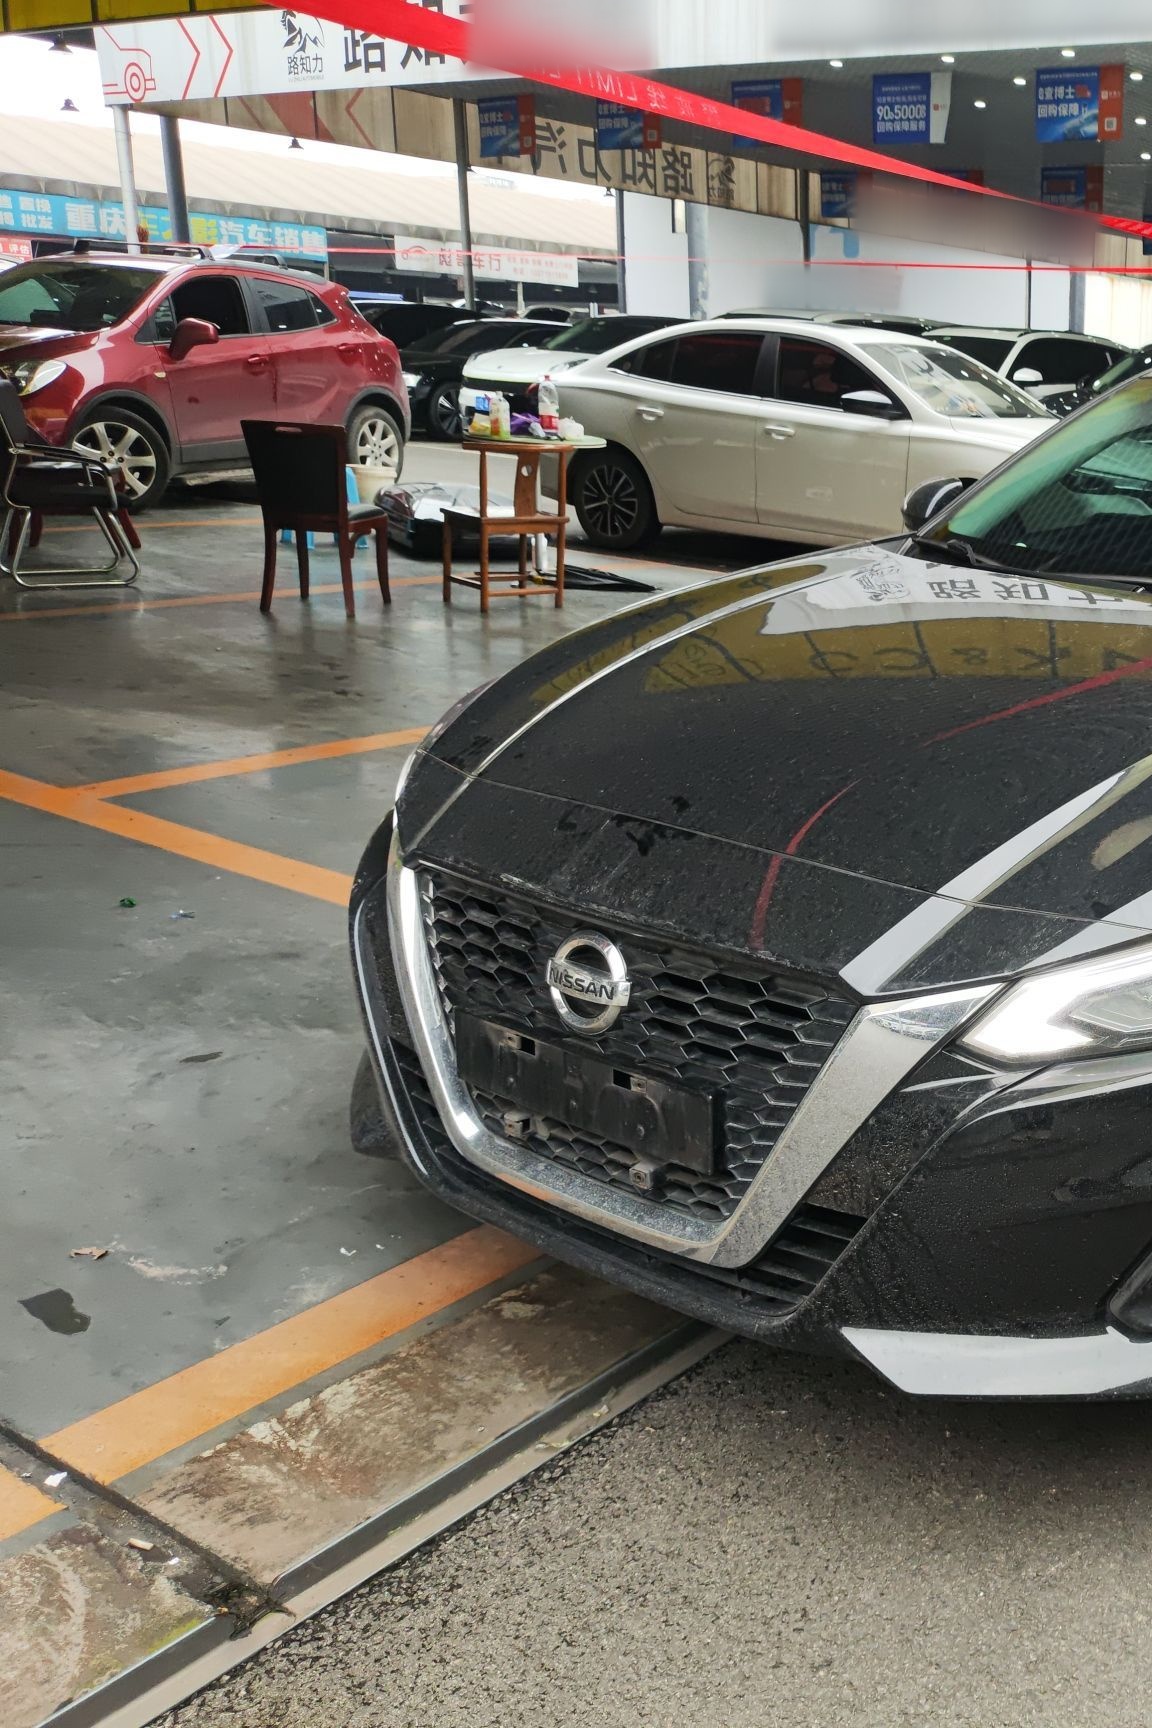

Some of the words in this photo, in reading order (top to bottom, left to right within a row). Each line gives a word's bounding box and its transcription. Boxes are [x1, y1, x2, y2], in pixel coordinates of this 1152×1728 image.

[287, 54, 324, 75] 路知力
[549, 967, 615, 1001] NISSAN
